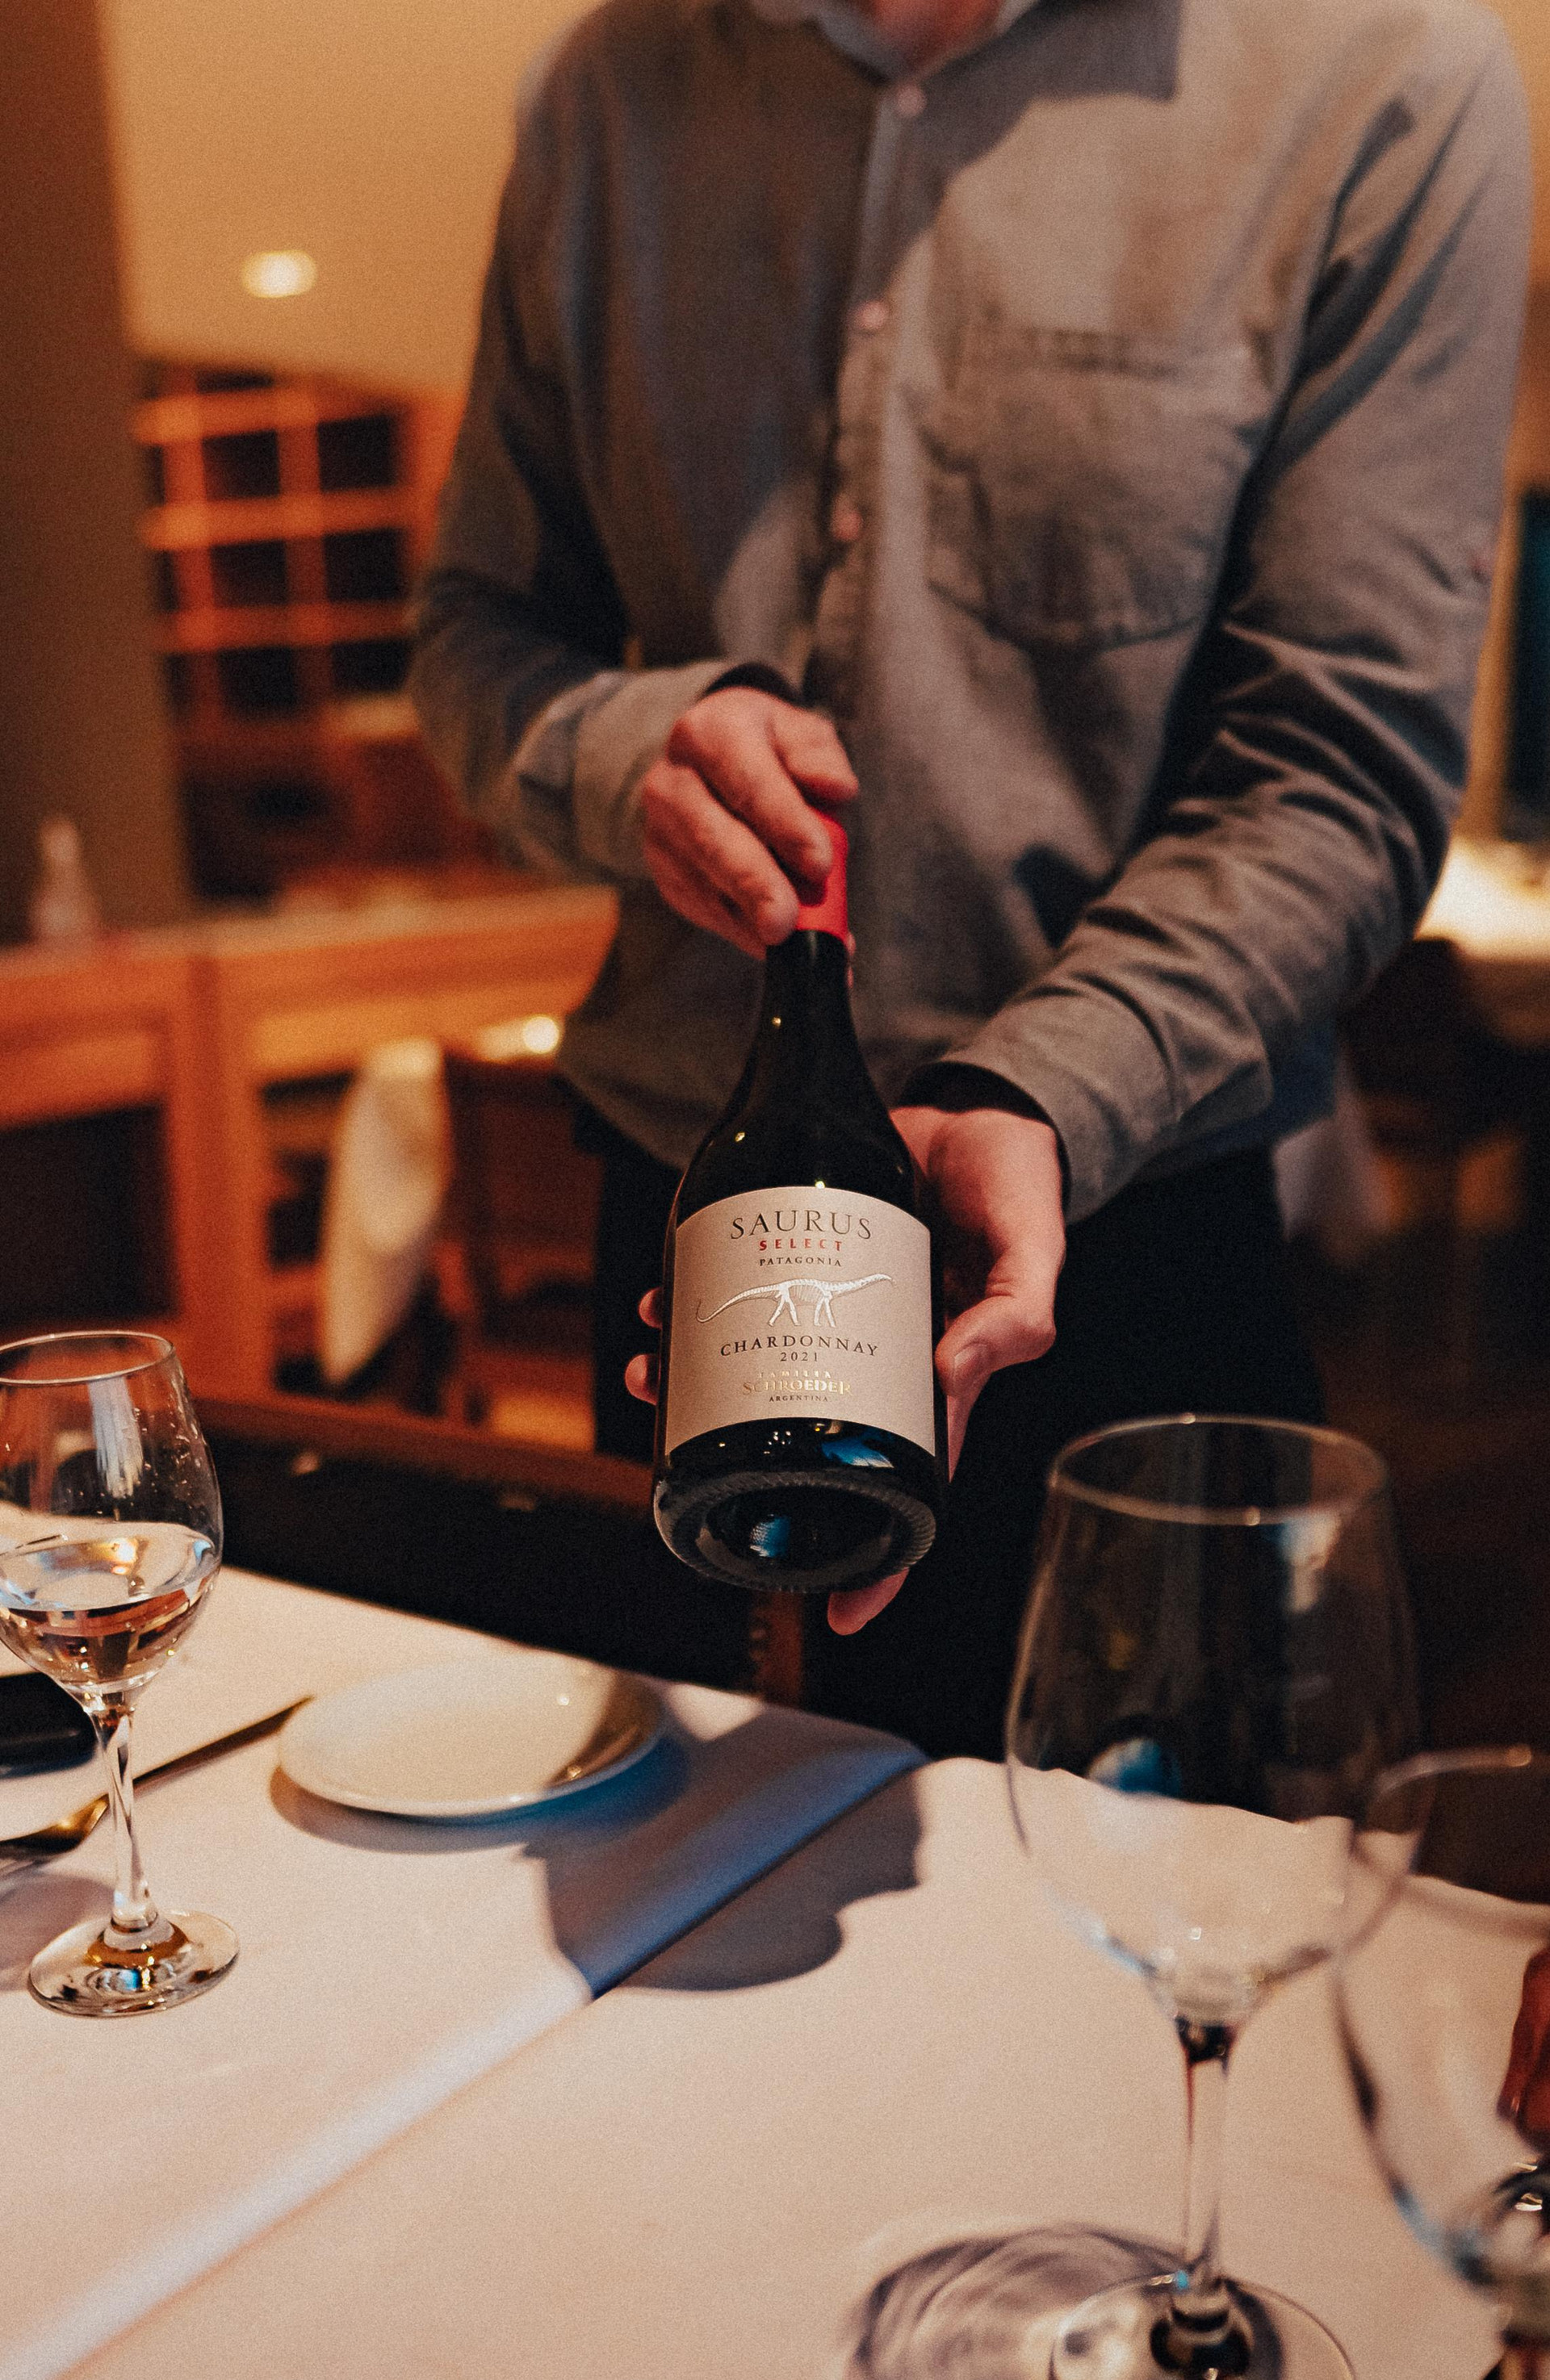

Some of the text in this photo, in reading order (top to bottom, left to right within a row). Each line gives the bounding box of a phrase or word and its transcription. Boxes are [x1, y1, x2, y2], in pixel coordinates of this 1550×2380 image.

[731, 1210, 871, 1240] SAURUS
[759, 1238, 843, 1252] SELECT
[759, 1257, 842, 1267] PATAGONIA
[720, 1335, 878, 1357] CHARDONNAY
[780, 1352, 819, 1362] 2021
[742, 1379, 853, 1396] SCHROEDER
[769, 1395, 828, 1403] ARGENTINA
